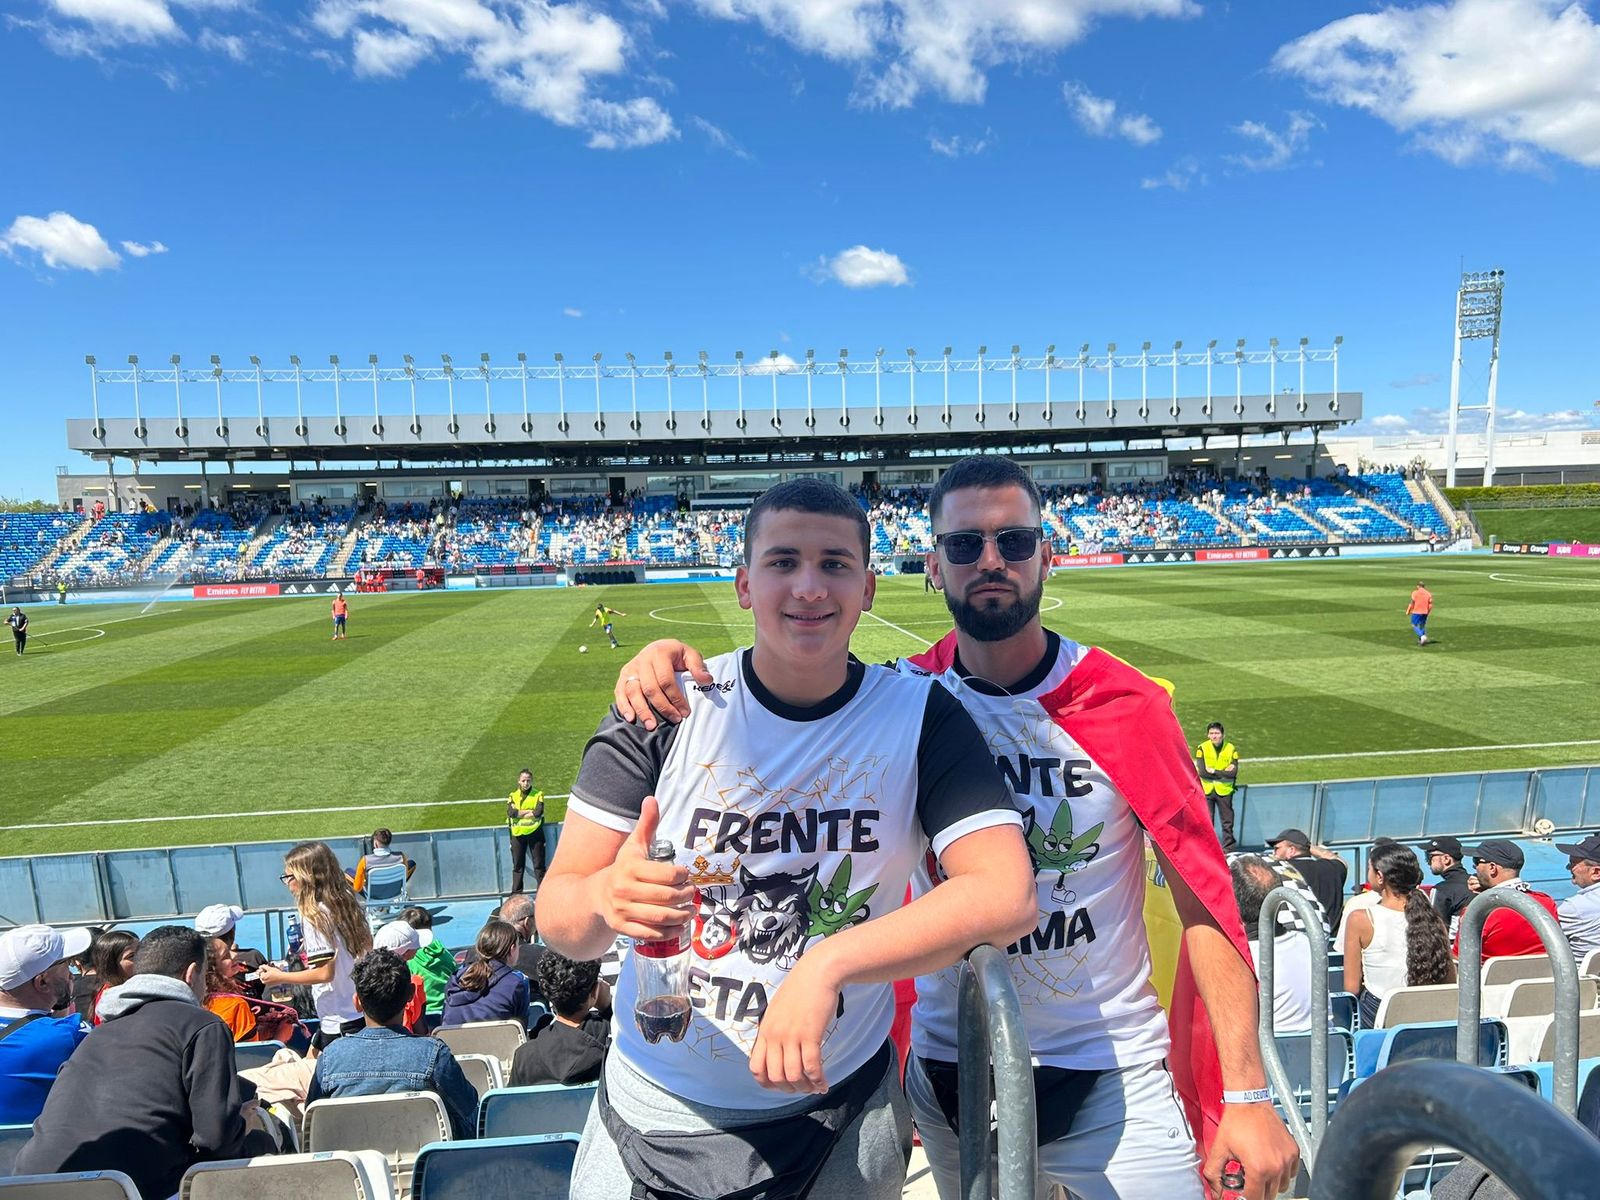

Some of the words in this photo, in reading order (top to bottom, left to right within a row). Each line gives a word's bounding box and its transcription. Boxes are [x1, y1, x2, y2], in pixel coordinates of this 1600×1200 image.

[1503, 544, 1520, 553] Orange
[1530, 545, 1548, 554] Orange
[1206, 551, 1234, 559] Emirates
[1060, 556, 1088, 565] Emirates
[206, 587, 239, 596] Emirates
[249, 586, 267, 594] BETTER
[996, 753, 1094, 798] NTE
[684, 807, 880, 854] FRENTE
[1244, 1091, 1252, 1101] AD
